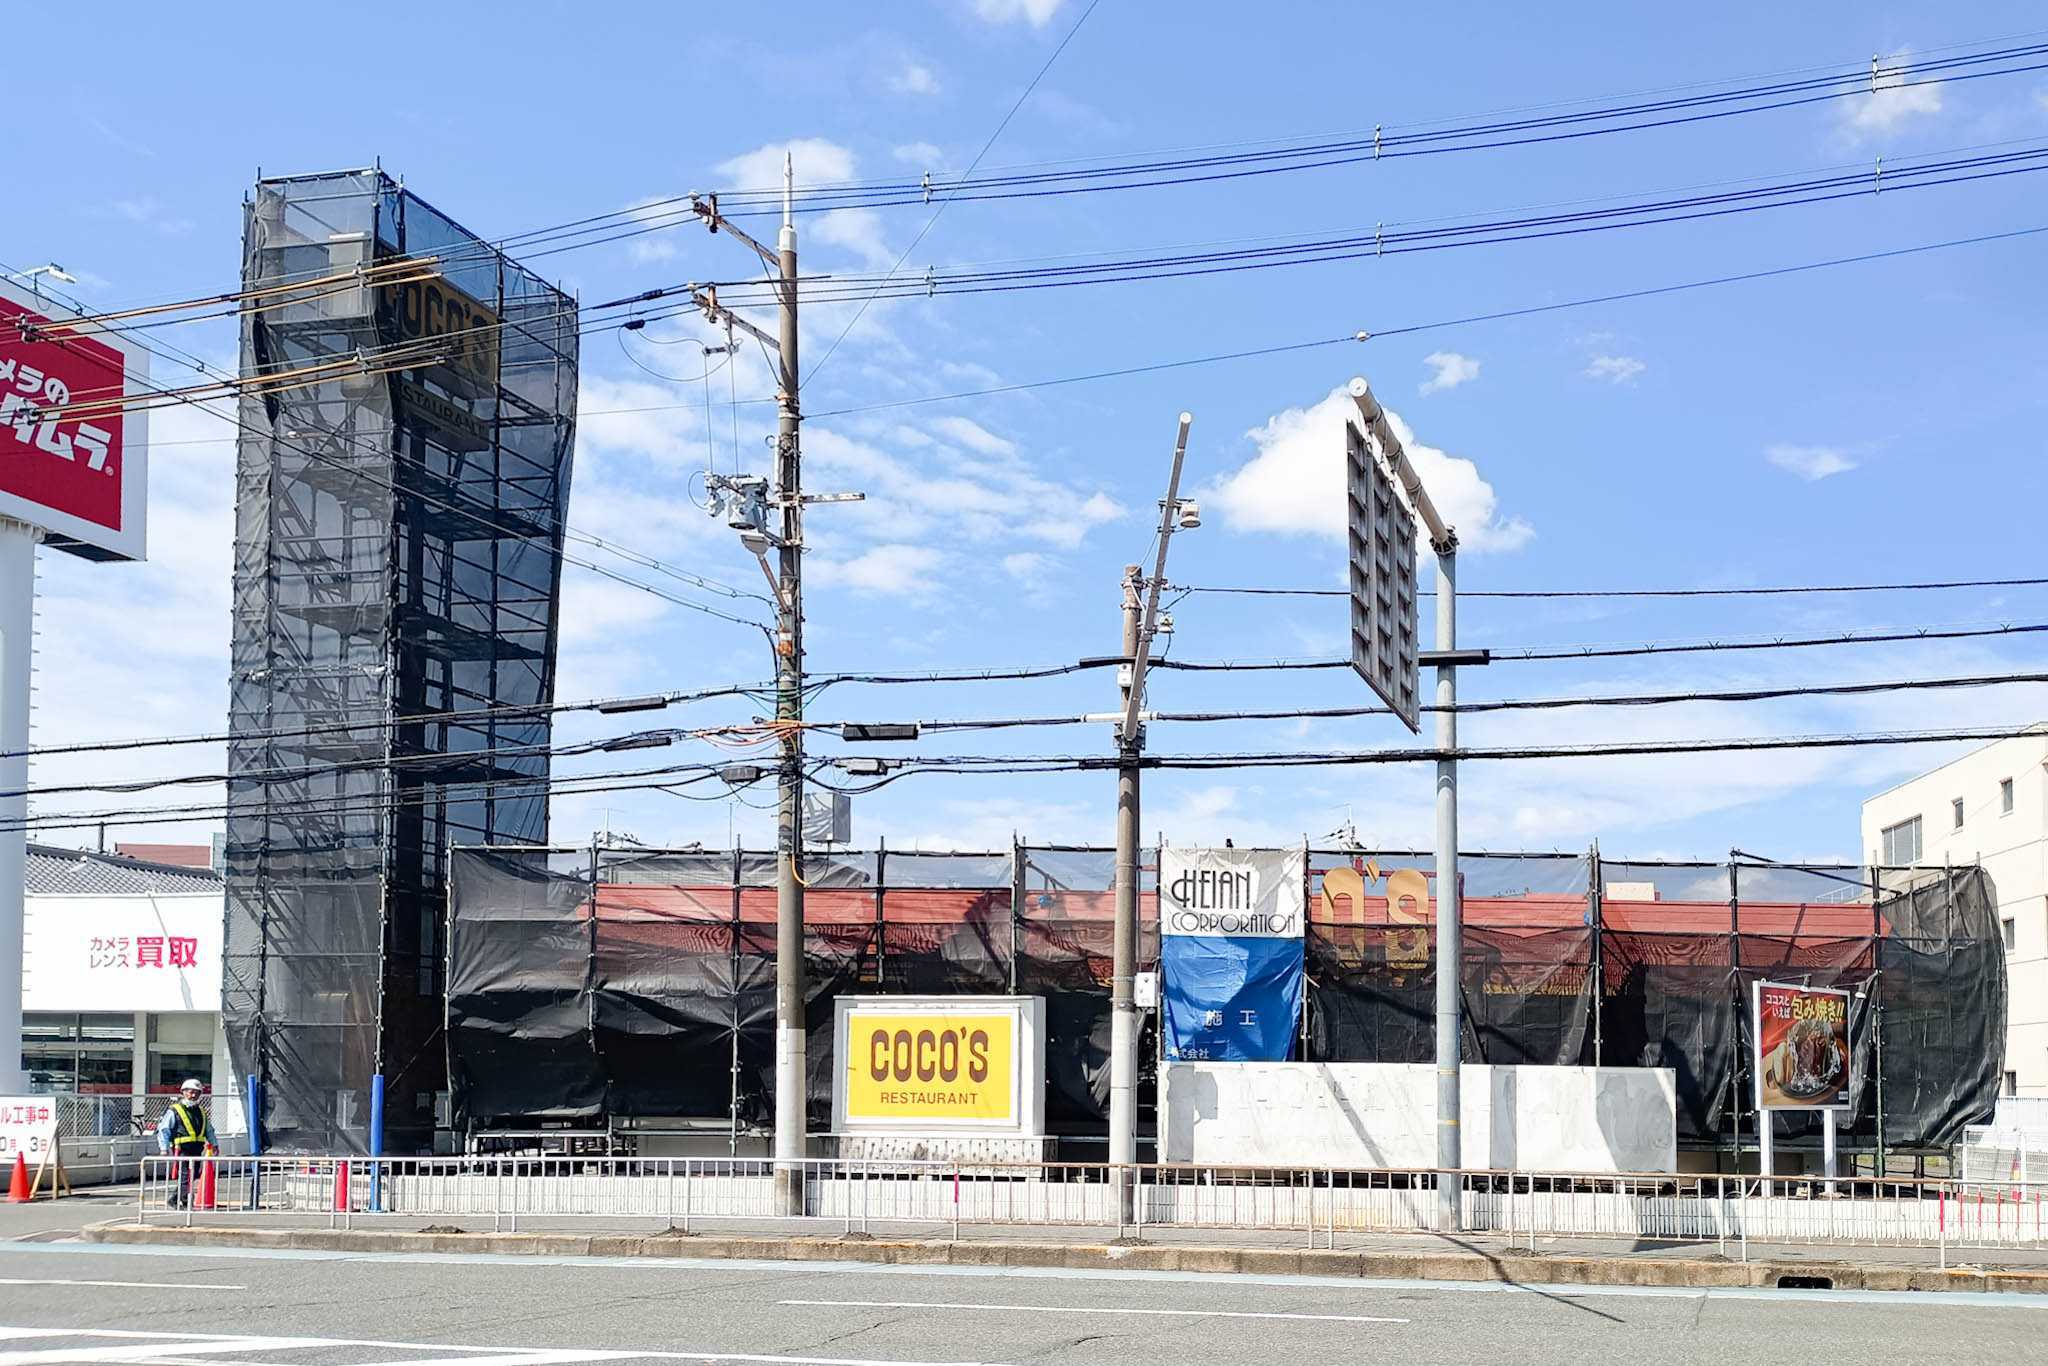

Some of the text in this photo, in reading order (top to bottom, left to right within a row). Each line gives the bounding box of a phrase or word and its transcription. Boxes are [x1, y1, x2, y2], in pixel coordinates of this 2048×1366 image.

[1171, 869, 1250, 909] HEIAN
[1171, 912, 1295, 933] CORPORATION
[90, 937, 129, 951] カメラ
[136, 937, 198, 968] 買取
[1765, 994, 1790, 1007] ココスと
[1772, 1006, 1791, 1019] いえば
[871, 1026, 989, 1083] COCO'S
[881, 1092, 978, 1105] RESTAURANT
